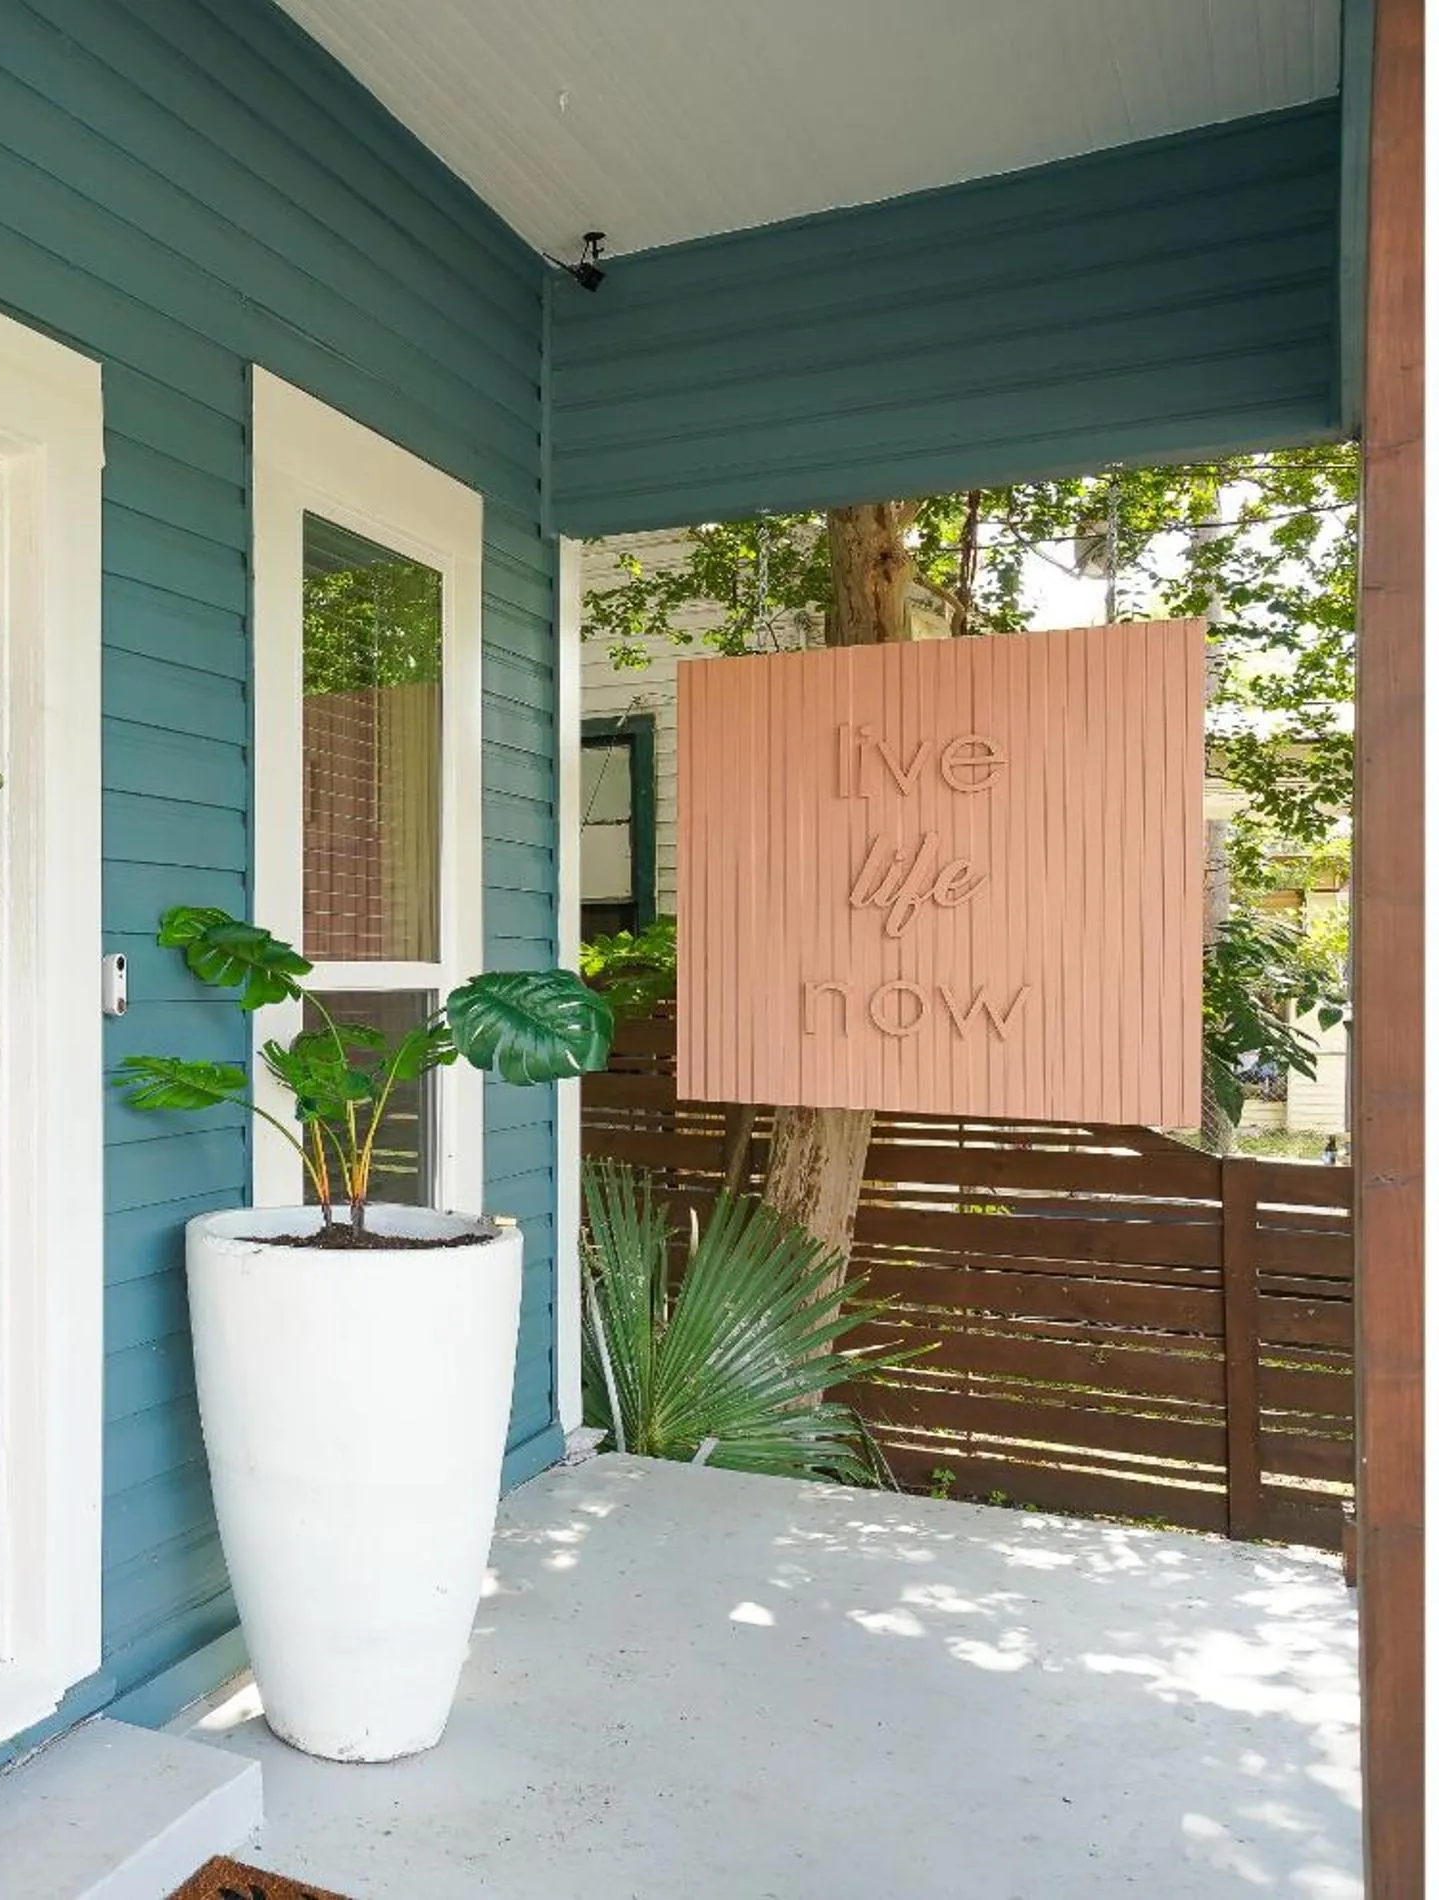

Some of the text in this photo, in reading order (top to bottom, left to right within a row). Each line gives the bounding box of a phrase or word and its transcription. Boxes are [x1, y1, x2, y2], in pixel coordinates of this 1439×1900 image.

[836, 722, 1009, 799] live
[849, 830, 990, 939] life
[803, 981, 1032, 1041] now
